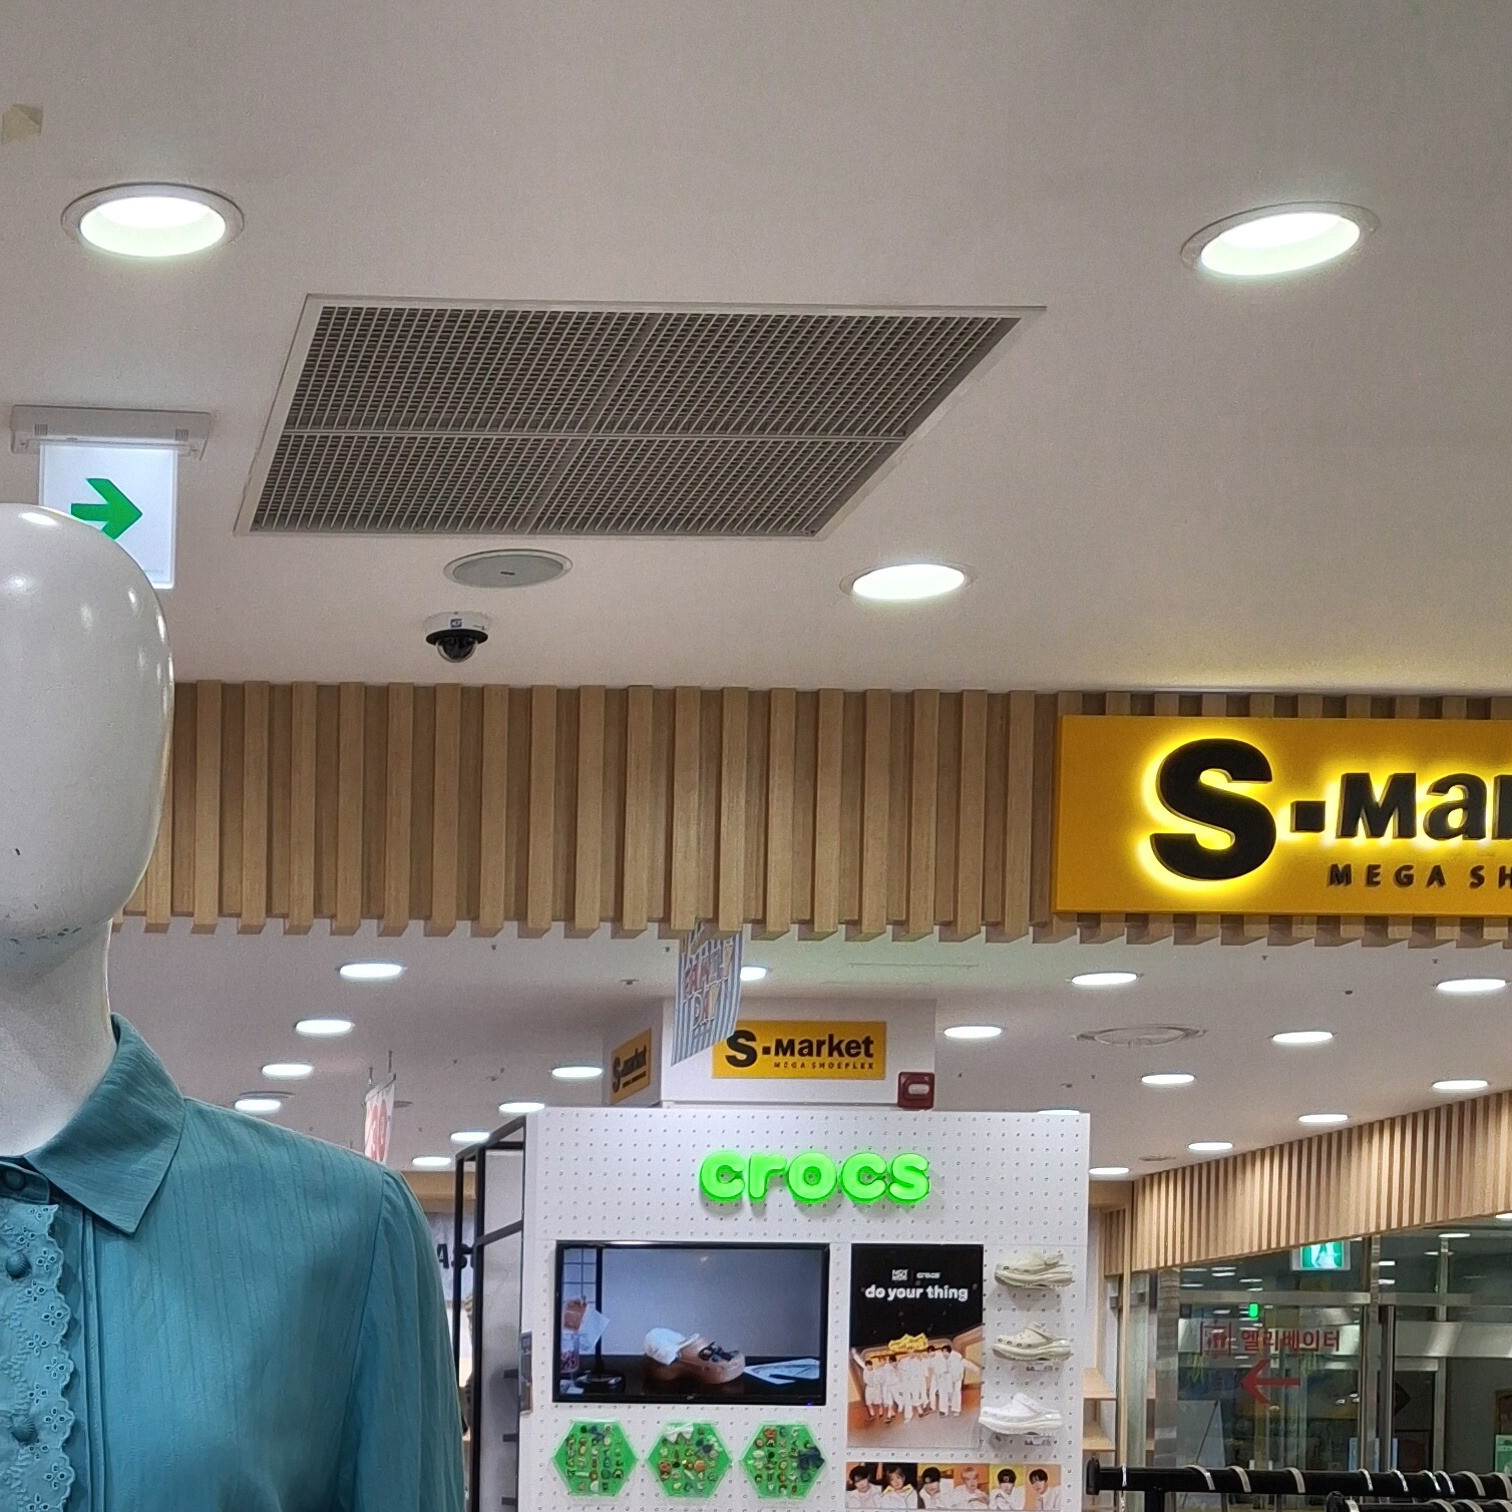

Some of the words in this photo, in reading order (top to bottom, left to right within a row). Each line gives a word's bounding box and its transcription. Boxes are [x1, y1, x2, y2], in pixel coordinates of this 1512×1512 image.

[1328, 863, 1446, 888] MEGA
[811, 1062, 874, 1070] SHOEPLEX
[699, 1150, 930, 1202] crocs
[865, 1284, 886, 1299] do
[887, 1287, 924, 1301] your
[926, 1284, 968, 1302] thing
[1241, 1329, 1340, 1352] 엘리베이터
